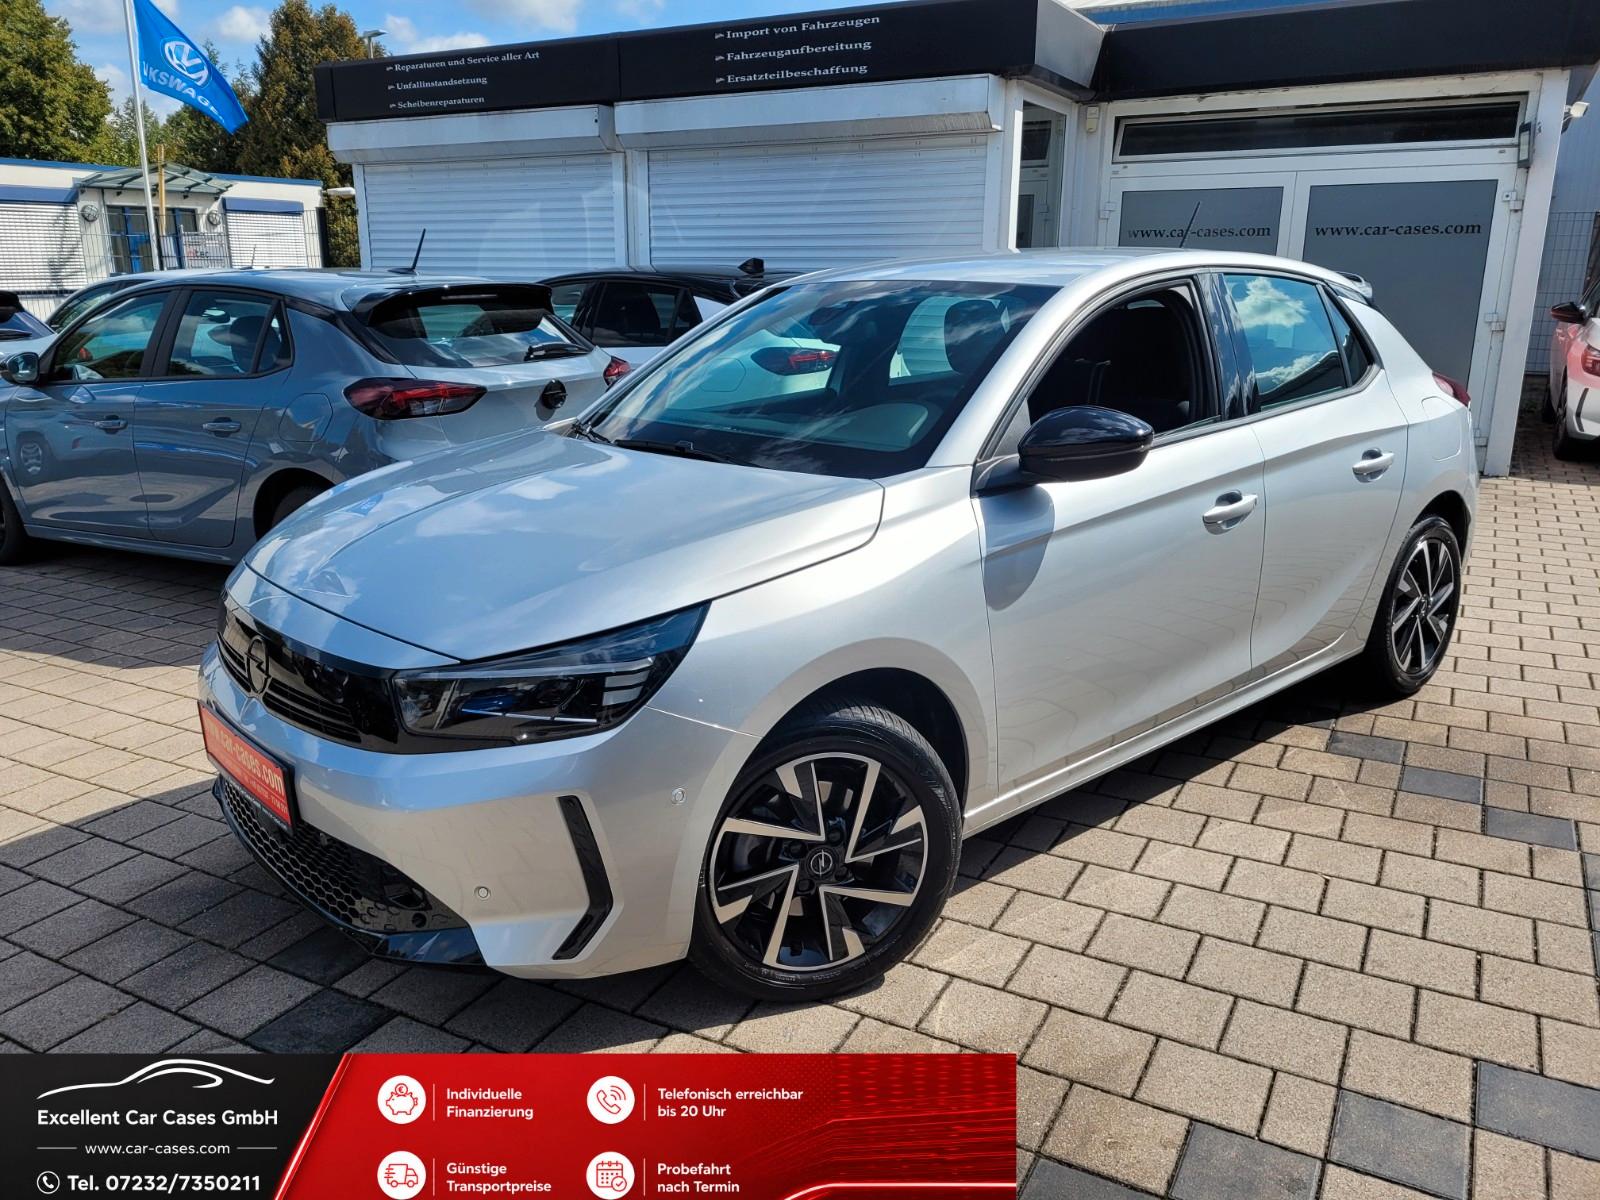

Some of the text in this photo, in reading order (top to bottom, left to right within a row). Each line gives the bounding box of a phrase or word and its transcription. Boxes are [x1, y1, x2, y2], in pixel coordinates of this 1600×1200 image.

[726, 16, 880, 40] Import von Fahrzeugen
[727, 41, 872, 61] Fahrzeugaufbereitung
[395, 51, 540, 73] Reparaturen und Service aller Art
[727, 64, 868, 83] Ersatzteilbeschaffung
[396, 76, 488, 91] Unfallinstandsetzung
[397, 96, 485, 109] Scheibenreparaturen
[1315, 222, 1482, 237] www.car-cases.com
